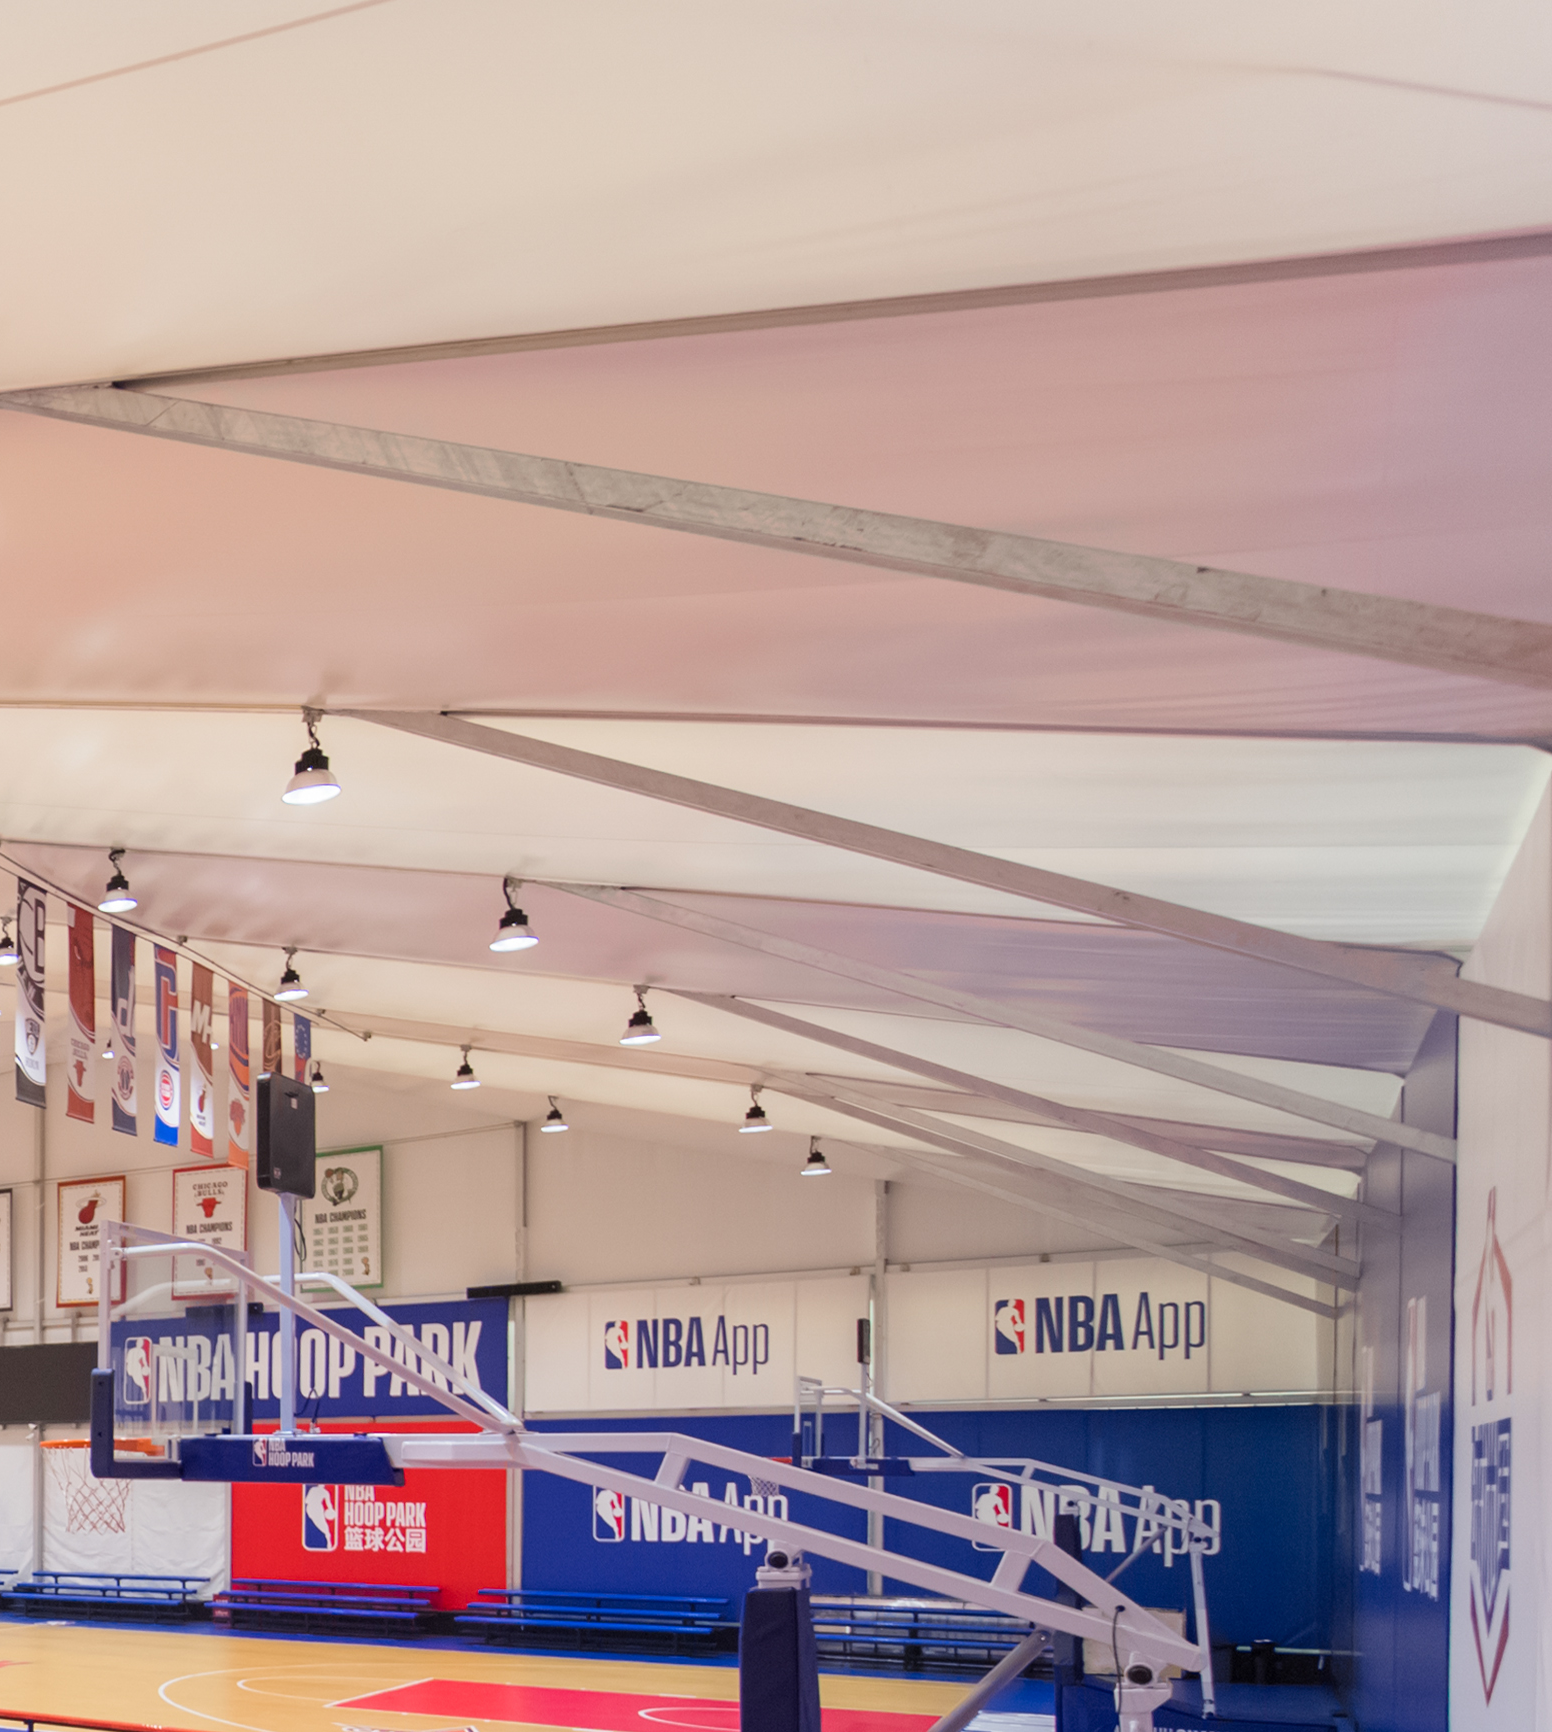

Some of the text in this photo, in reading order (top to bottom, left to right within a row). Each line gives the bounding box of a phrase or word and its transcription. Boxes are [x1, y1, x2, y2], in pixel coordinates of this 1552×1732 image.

[192, 1181, 228, 1190] CHICAGO
[197, 1189, 222, 1197] BULLS
[315, 1209, 367, 1224] NBA CHAMPIONS
[186, 1222, 233, 1234] NBA CHAMPIONS
[70, 1242, 80, 1251] NBA
[1035, 1291, 1207, 1361] NBA App
[636, 1314, 770, 1375] NBA App
[158, 1333, 236, 1402] NBA
[363, 1320, 483, 1398] PARK
[268, 1438, 286, 1451] NBA
[268, 1451, 314, 1468] HOOP PARK
[343, 1484, 376, 1501] NBA
[343, 1502, 426, 1527] HOOP PARK
[343, 1528, 427, 1554] 篮球公园
